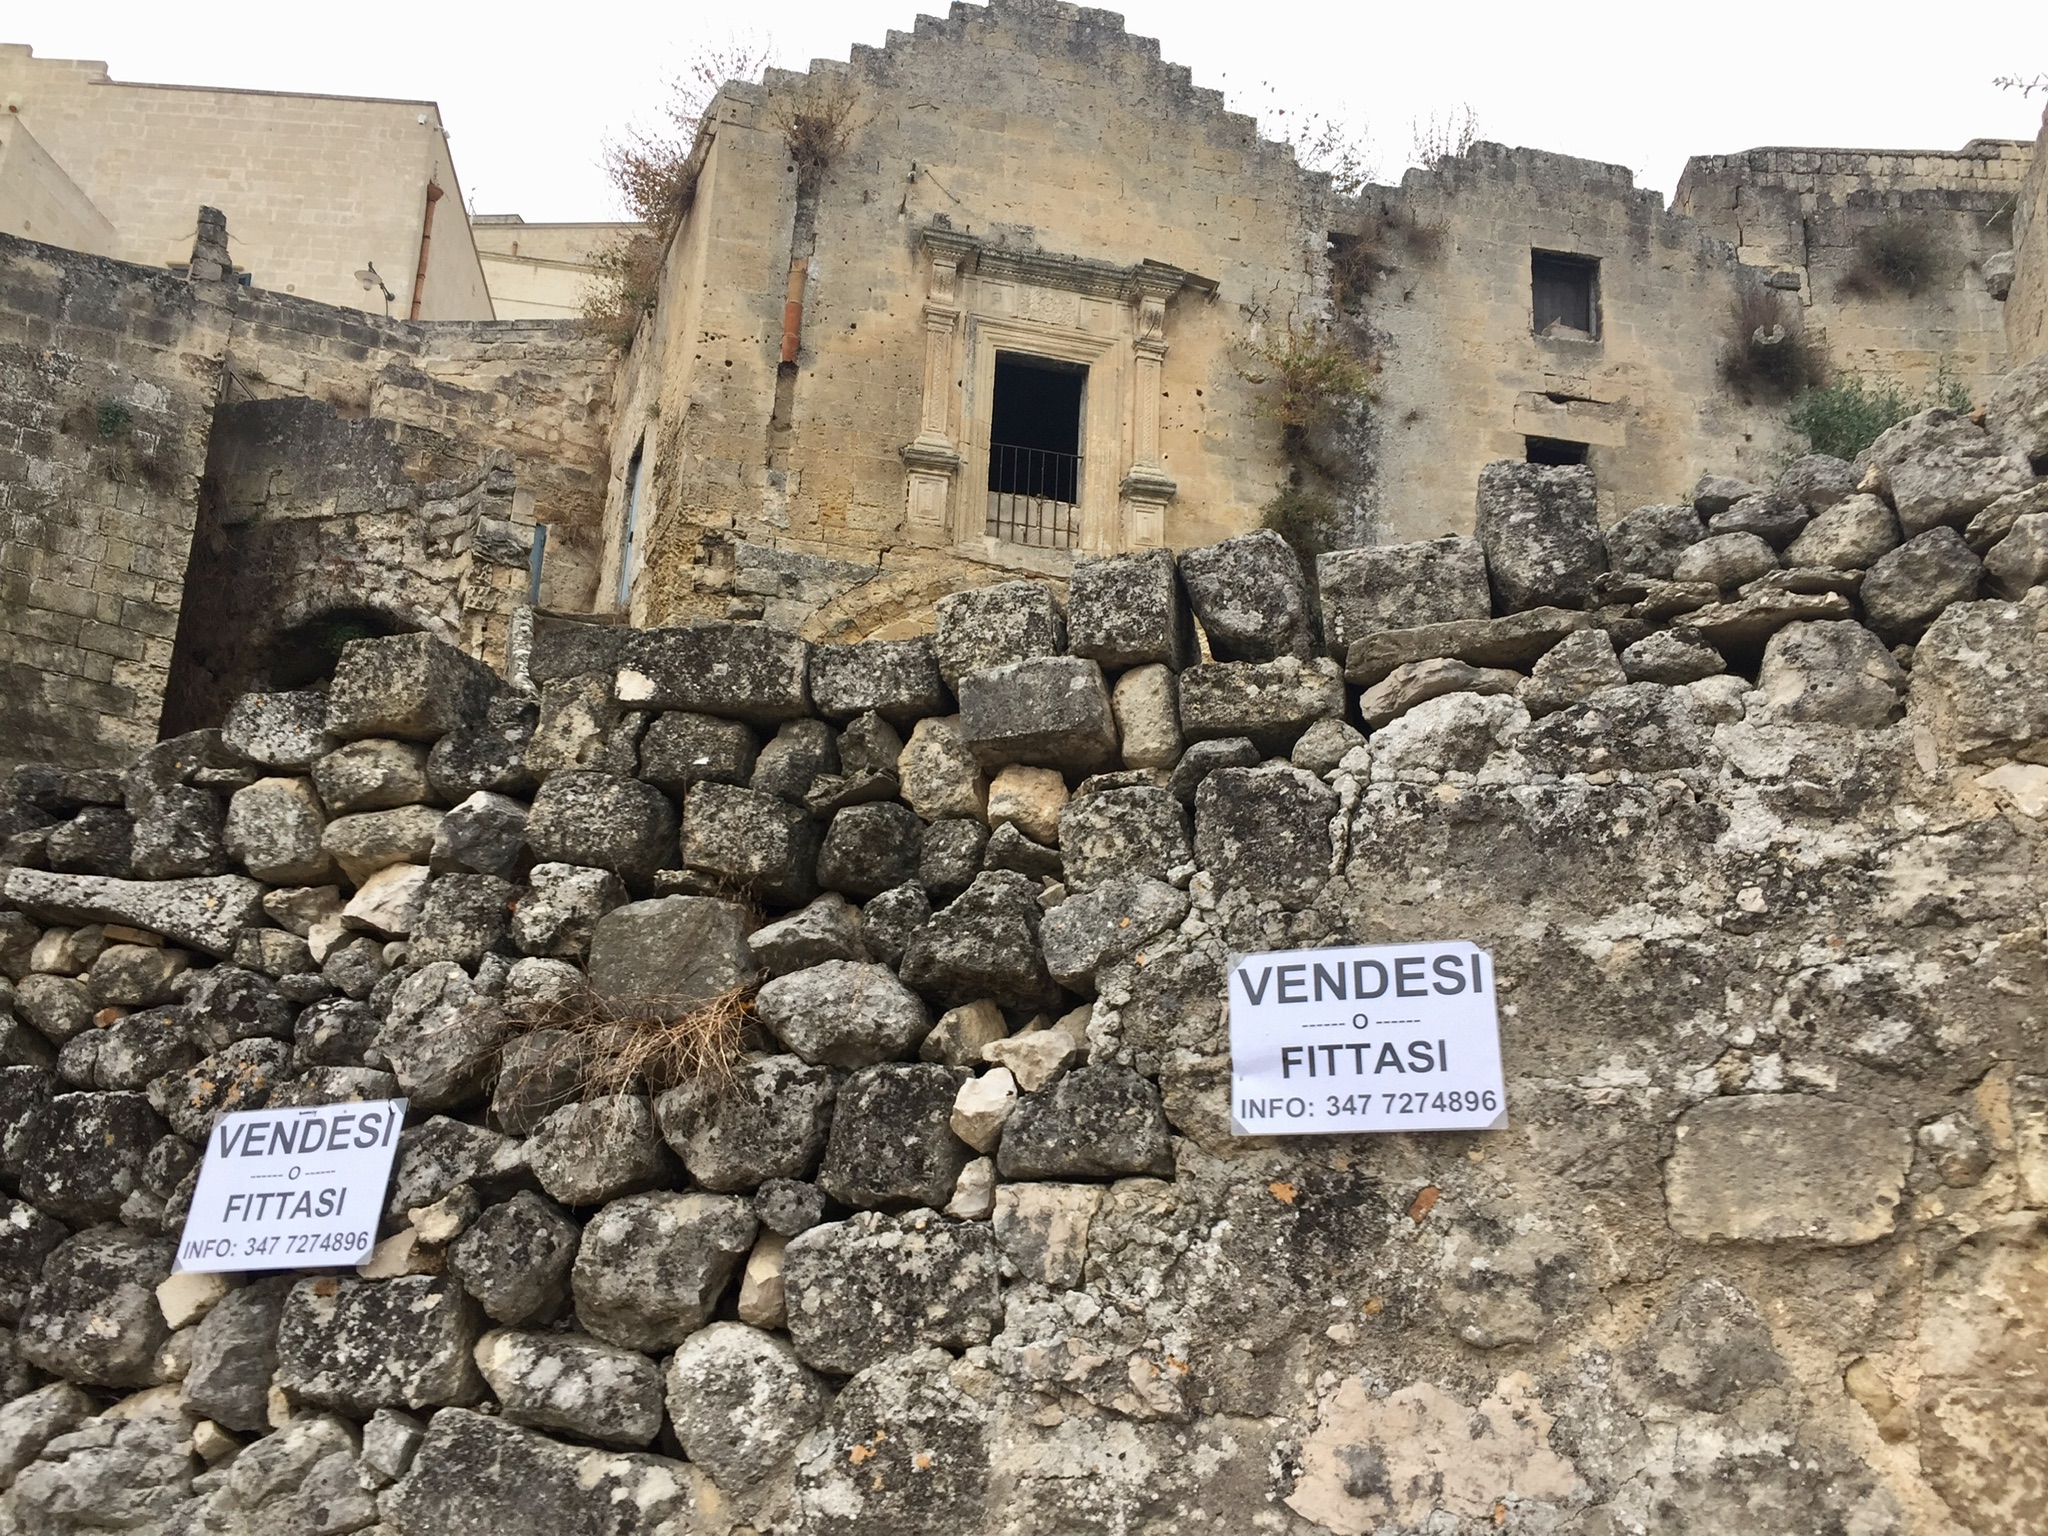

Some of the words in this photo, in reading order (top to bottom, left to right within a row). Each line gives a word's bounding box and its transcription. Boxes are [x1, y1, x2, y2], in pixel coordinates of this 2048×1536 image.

[1238, 953, 1482, 1006] VENDESI
[1281, 1039, 1448, 1079] FITTASI
[1241, 1097, 1314, 1119] INFO:
[1326, 1094, 1372, 1117] 347
[1382, 1090, 1497, 1115] 7274896
[220, 1111, 395, 1158] VENDESI
[222, 1187, 347, 1223] FITTASI
[182, 1238, 237, 1260] INFO:
[244, 1236, 281, 1257] 347
[285, 1231, 369, 1255] 7274896
